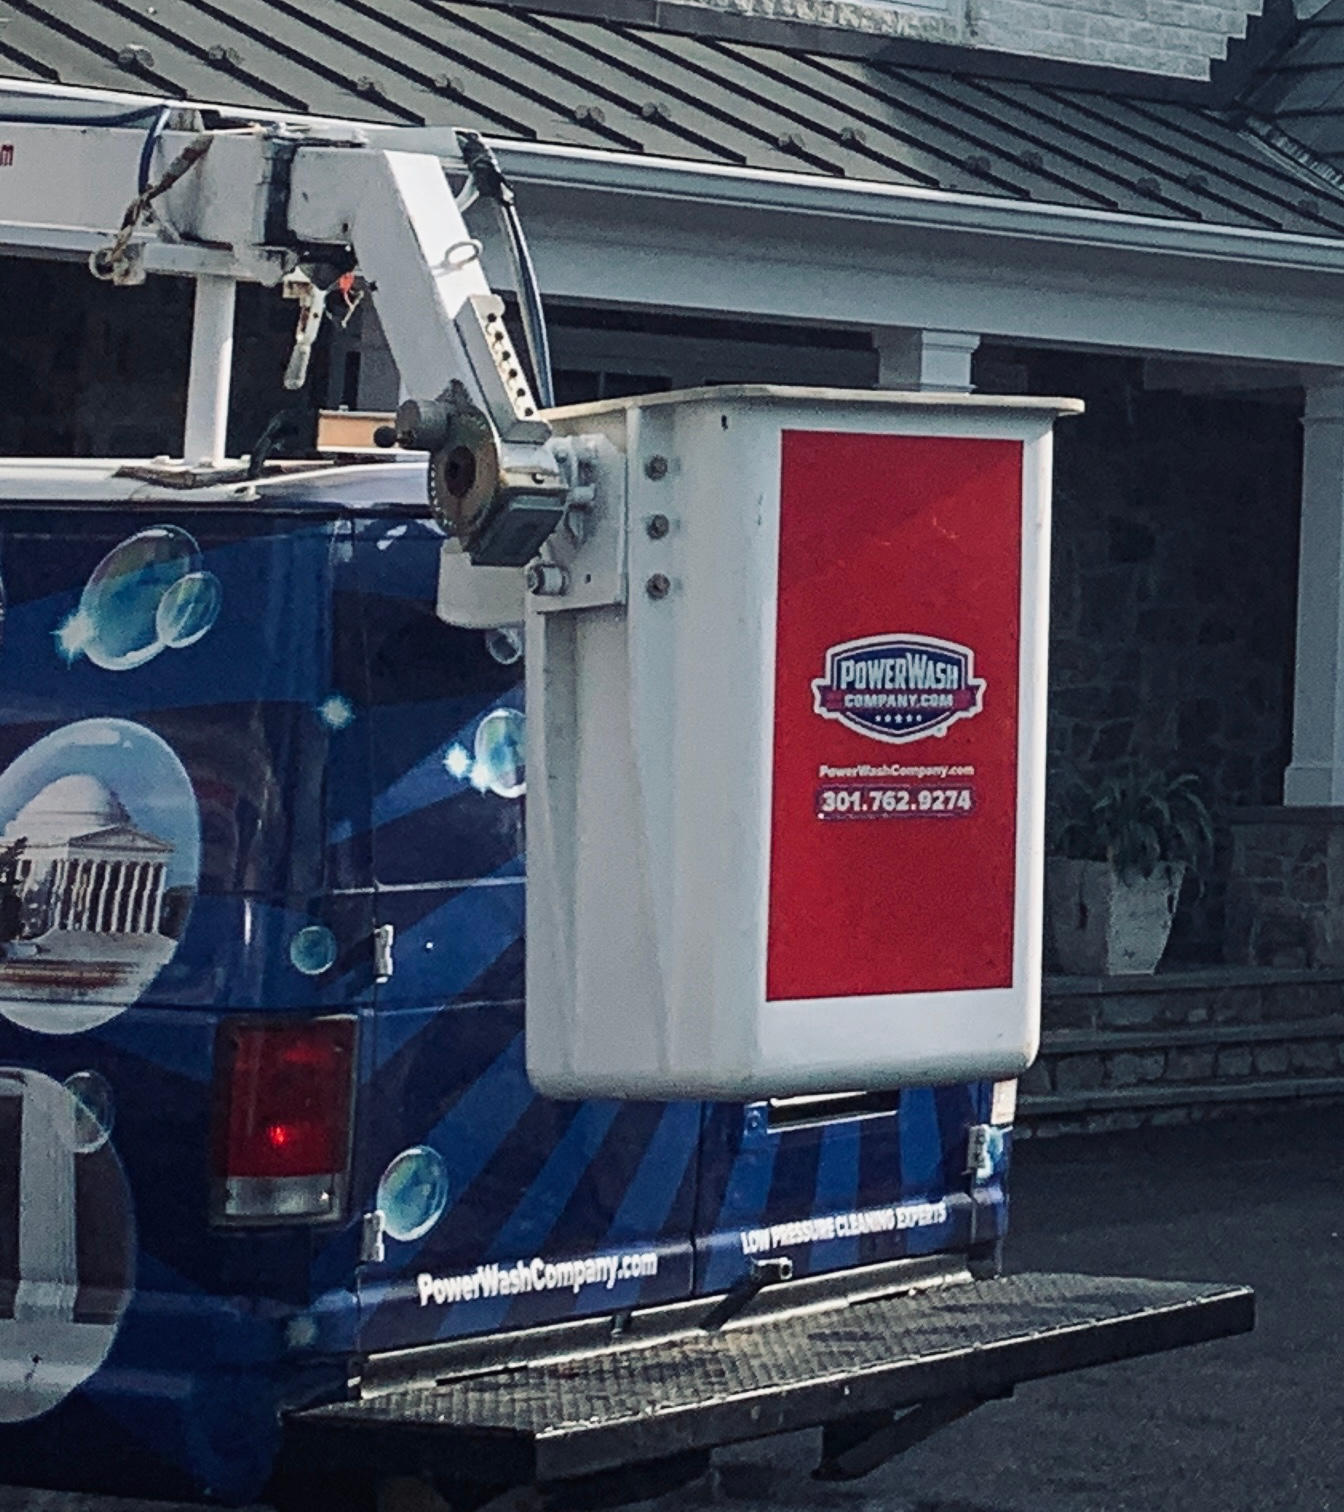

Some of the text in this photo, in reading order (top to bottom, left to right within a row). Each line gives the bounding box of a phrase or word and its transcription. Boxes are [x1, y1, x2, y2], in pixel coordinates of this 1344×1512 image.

[844, 693, 954, 708] COMPANY.COM
[819, 764, 975, 778] PowerWashCompany.com
[822, 790, 972, 812] 301.762.9274
[740, 1202, 947, 1255] LOW PRESSURE CLEANING EXPERTS
[416, 1252, 658, 1307] PowerWashCompany.com
